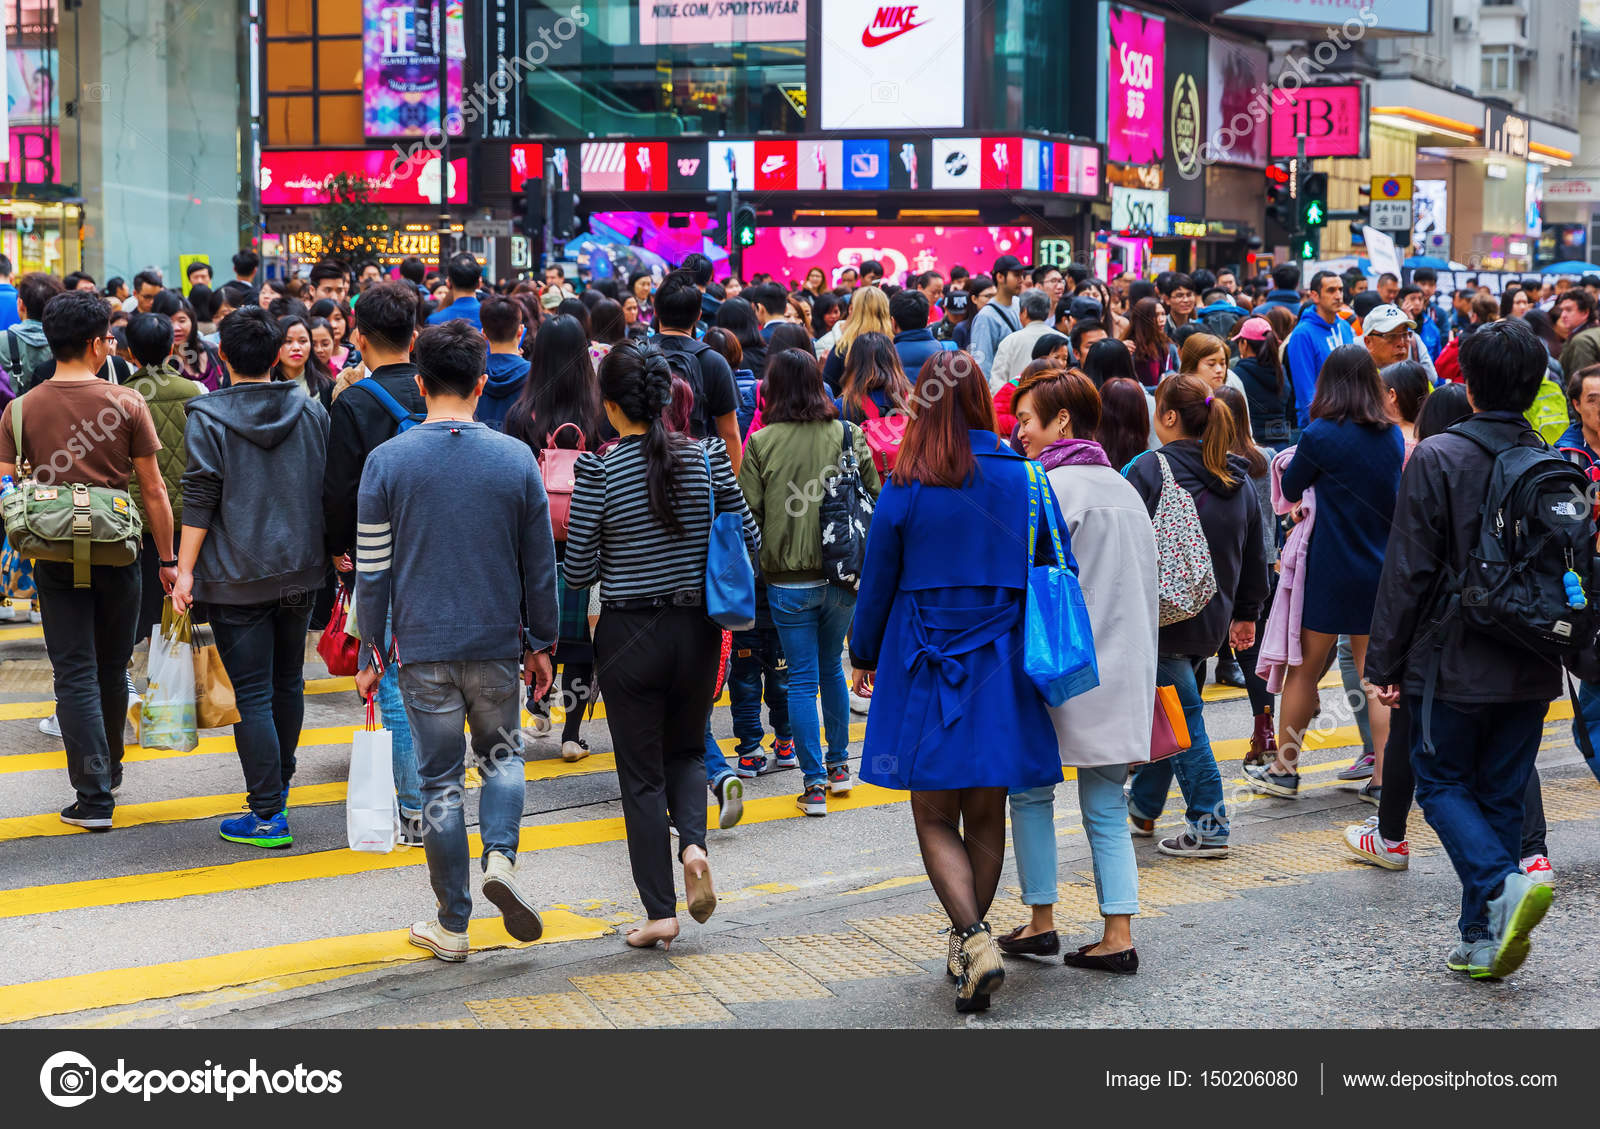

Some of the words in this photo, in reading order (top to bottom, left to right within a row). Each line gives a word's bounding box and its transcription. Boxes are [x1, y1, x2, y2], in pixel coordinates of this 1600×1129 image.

[651, 1, 799, 19] NIKE.COM/SPORTSWEAR
[872, 5, 919, 29] NIKE
[1292, 98, 1334, 137] iB
[1376, 203, 1388, 212] 24
